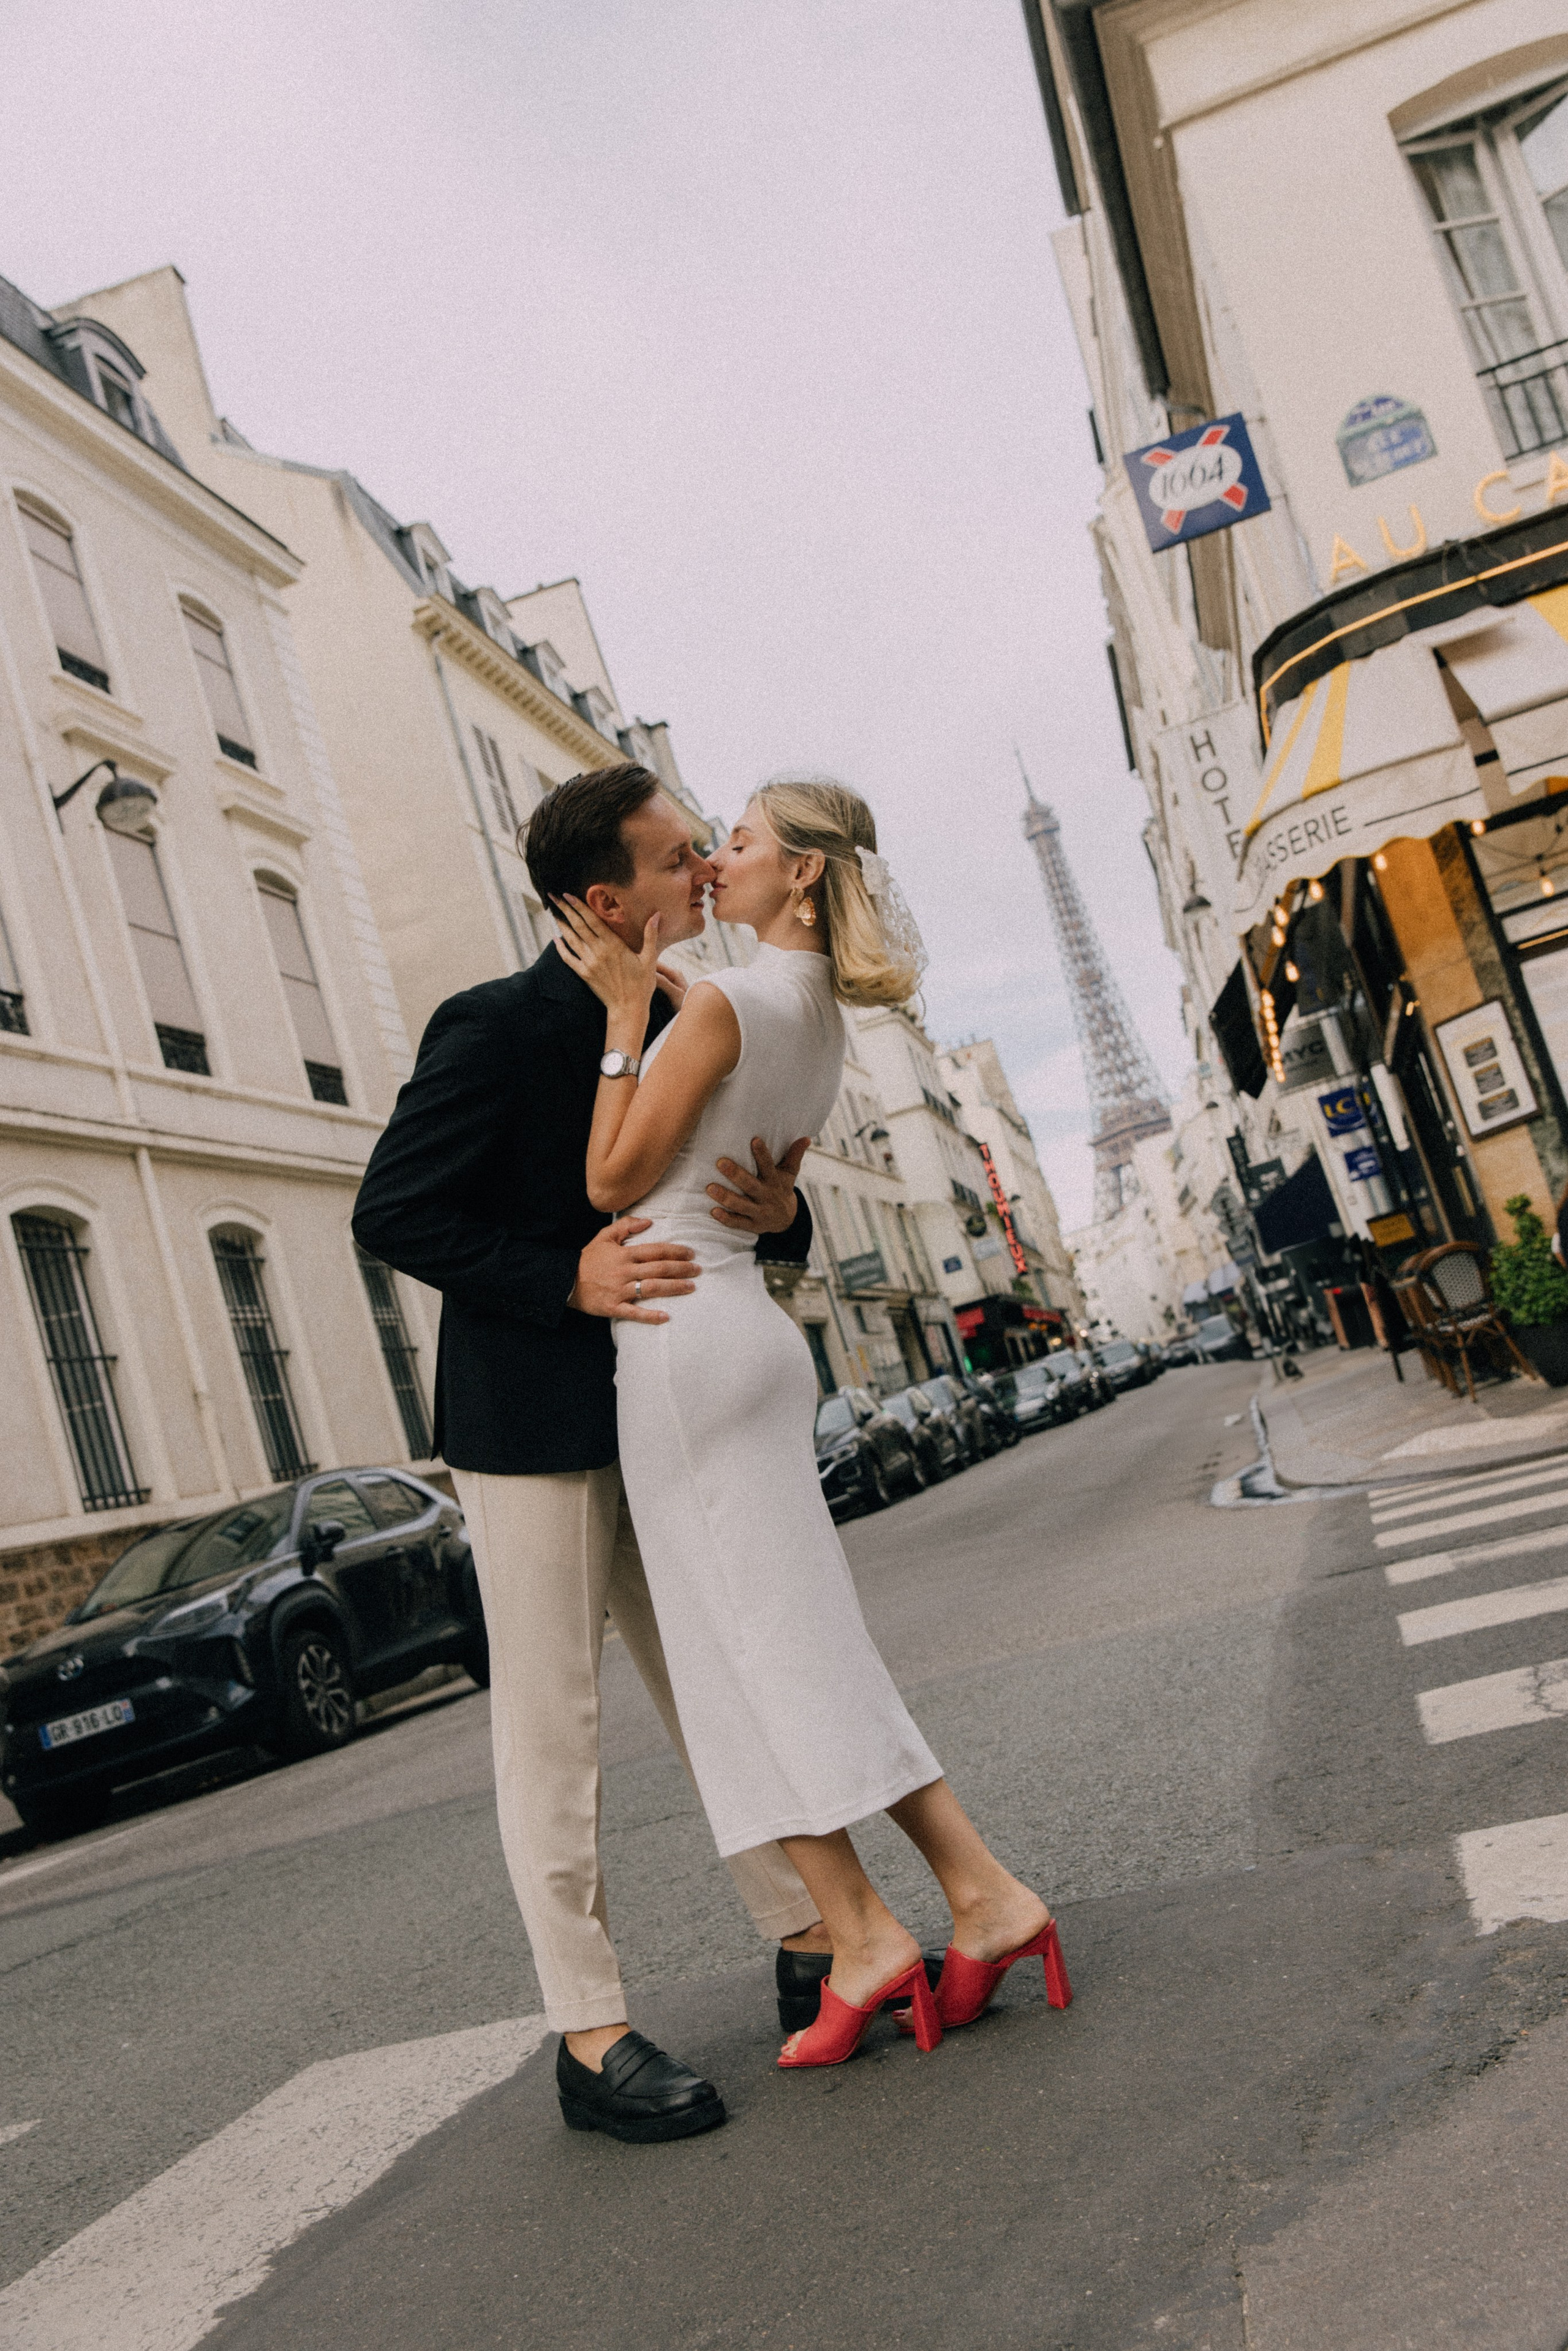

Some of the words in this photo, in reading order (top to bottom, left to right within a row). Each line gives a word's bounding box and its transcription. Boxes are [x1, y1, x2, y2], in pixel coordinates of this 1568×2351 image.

[1331, 504, 1428, 586] AU
[1189, 730, 1242, 860] HOTE
[1264, 805, 1352, 870] SSERIE
